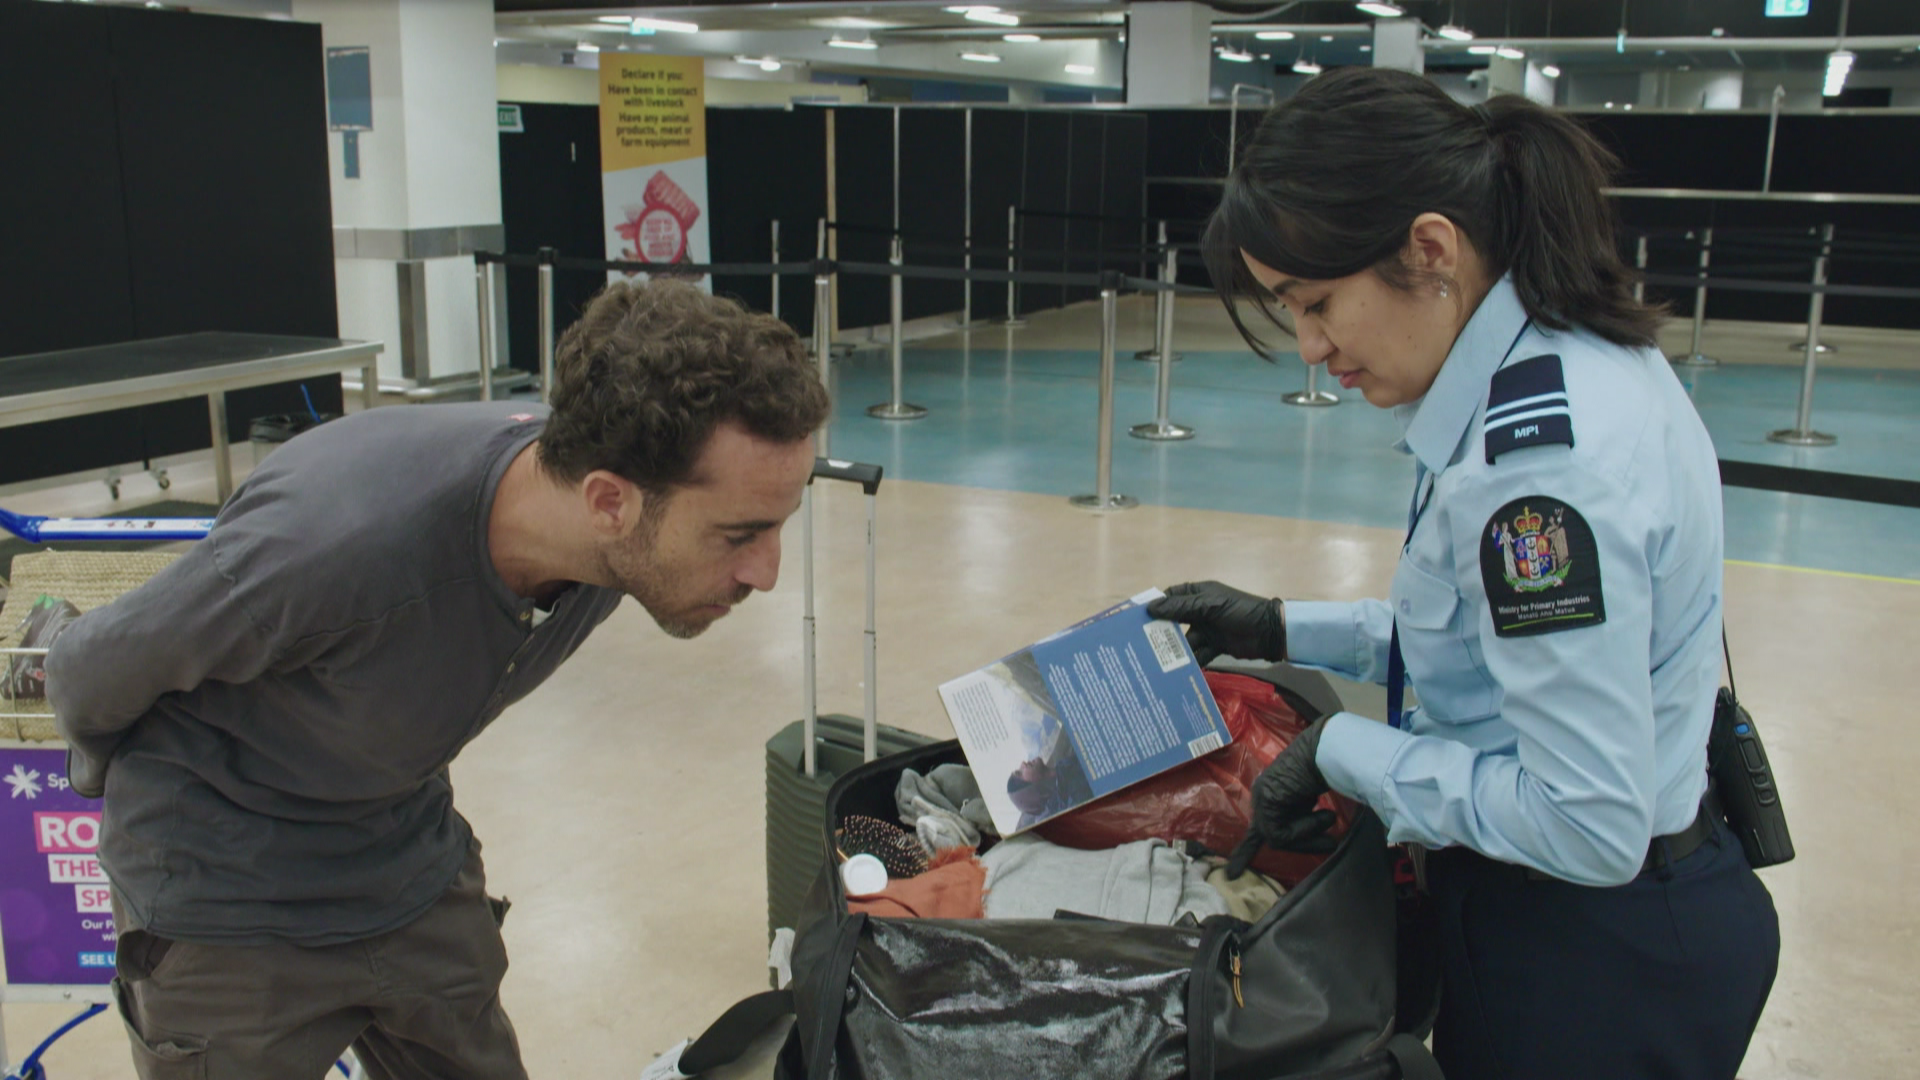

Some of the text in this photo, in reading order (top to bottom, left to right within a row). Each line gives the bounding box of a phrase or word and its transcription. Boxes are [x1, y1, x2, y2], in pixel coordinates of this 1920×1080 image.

[621, 68, 655, 79] Declare
[658, 70, 664, 79] if
[608, 84, 697, 97] Have been in contact
[623, 97, 684, 108] with livestock
[619, 112, 689, 125] Have any animal
[616, 126, 693, 137] products, meat or
[621, 137, 690, 149] farm equipment
[1514, 424, 1540, 439] MPI
[1498, 595, 1590, 615] Ministry for Primary Industries
[53, 859, 101, 877] THE
[81, 890, 111, 907] SP
[81, 919, 104, 930] Our
[81, 953, 105, 966] SEE
